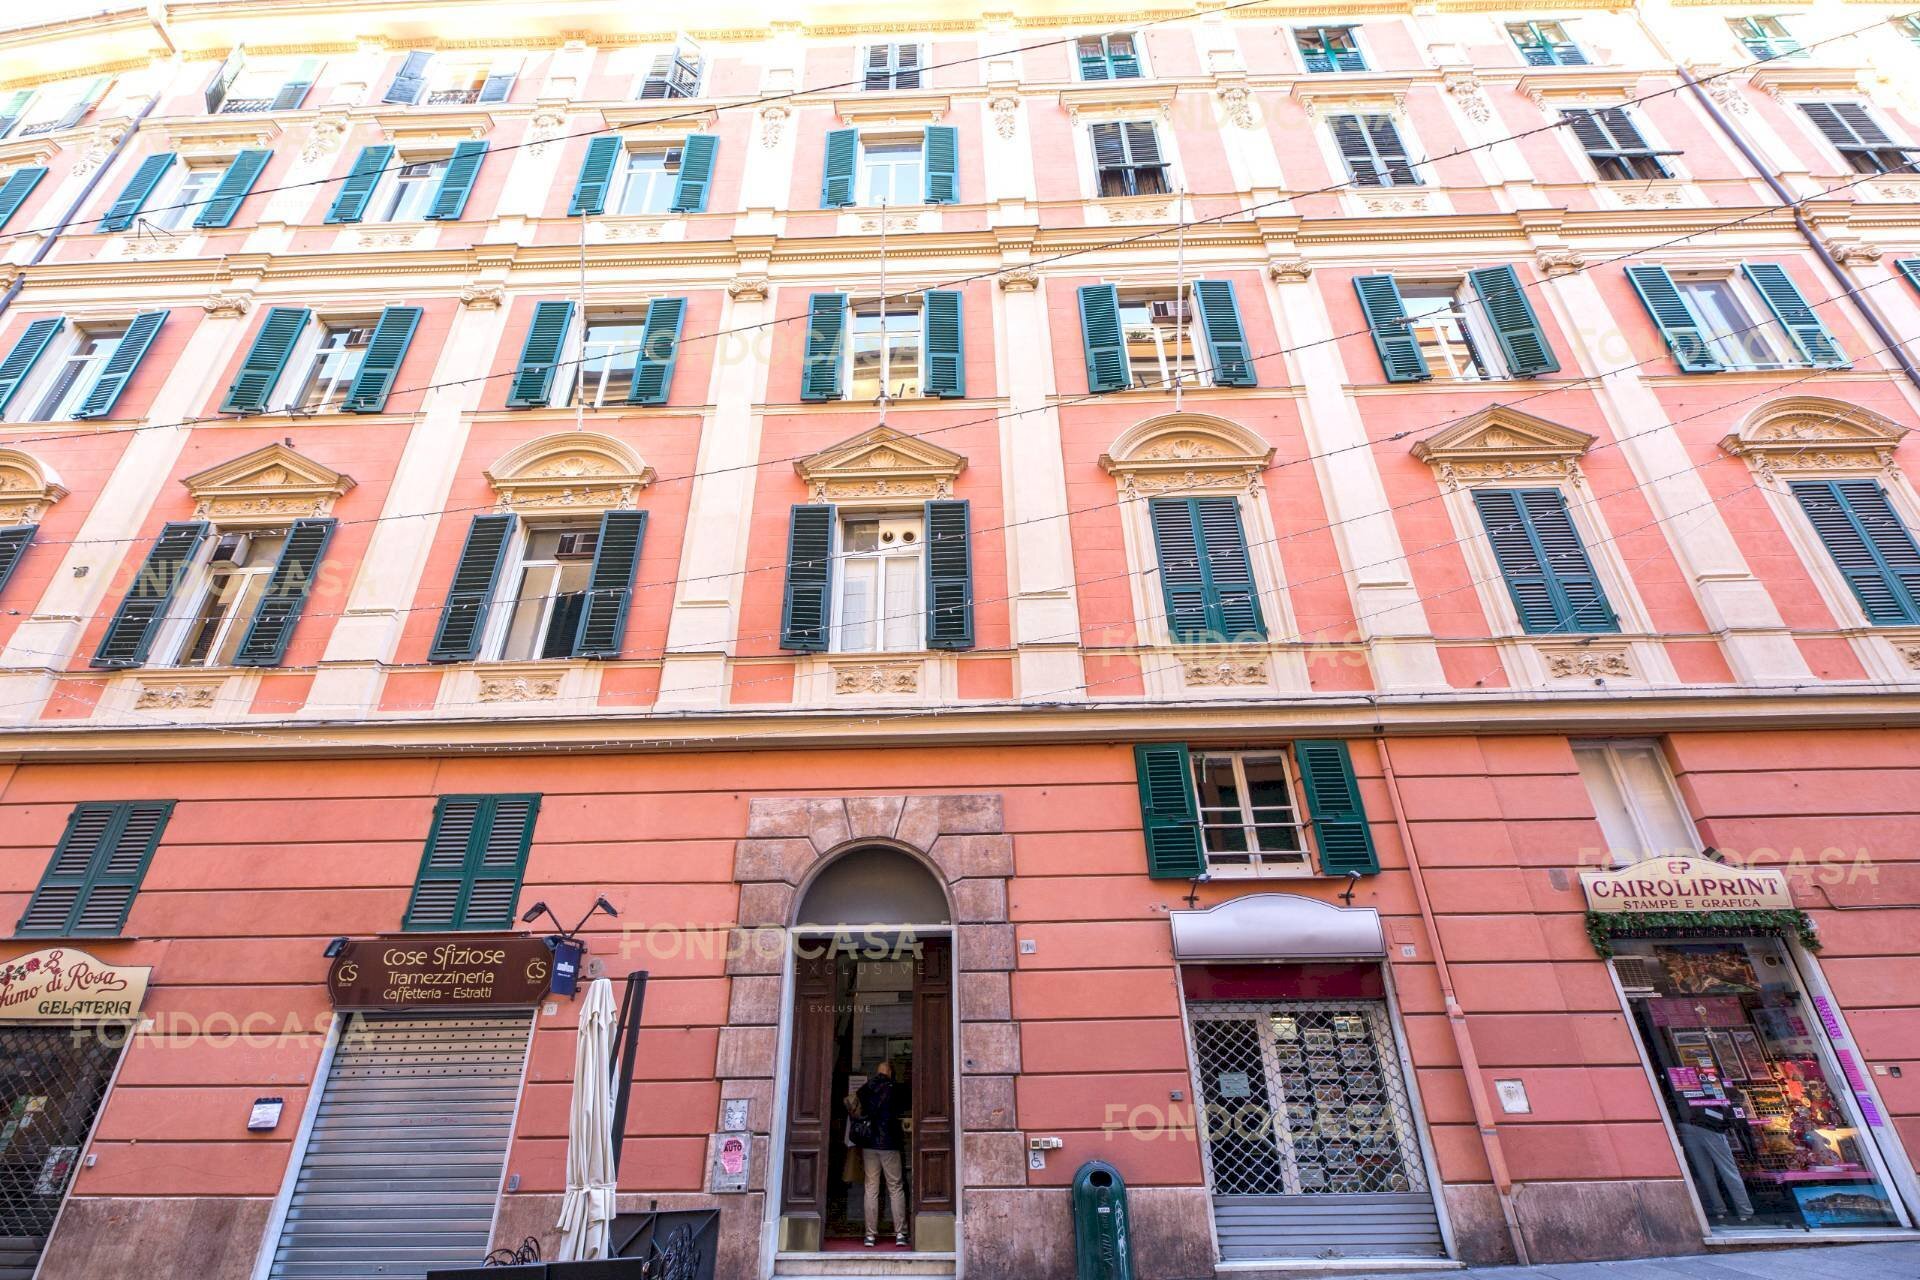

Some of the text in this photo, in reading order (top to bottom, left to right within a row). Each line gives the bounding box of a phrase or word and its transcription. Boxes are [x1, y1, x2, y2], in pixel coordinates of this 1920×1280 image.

[1592, 877, 1778, 899] CAIROLIPRINT
[1623, 898, 1761, 910] STAMPE E GRAFICA
[383, 943, 506, 970] Cose Sfiziose
[338, 963, 359, 982] CS
[388, 970, 494, 986] Tramezzineria
[526, 961, 546, 979] CS
[0, 961, 128, 1009] fumo di Rosa
[453, 987, 493, 999] Estratti
[38, 1000, 132, 1016] GELATERIA
[723, 1144, 742, 1153] AUTO
